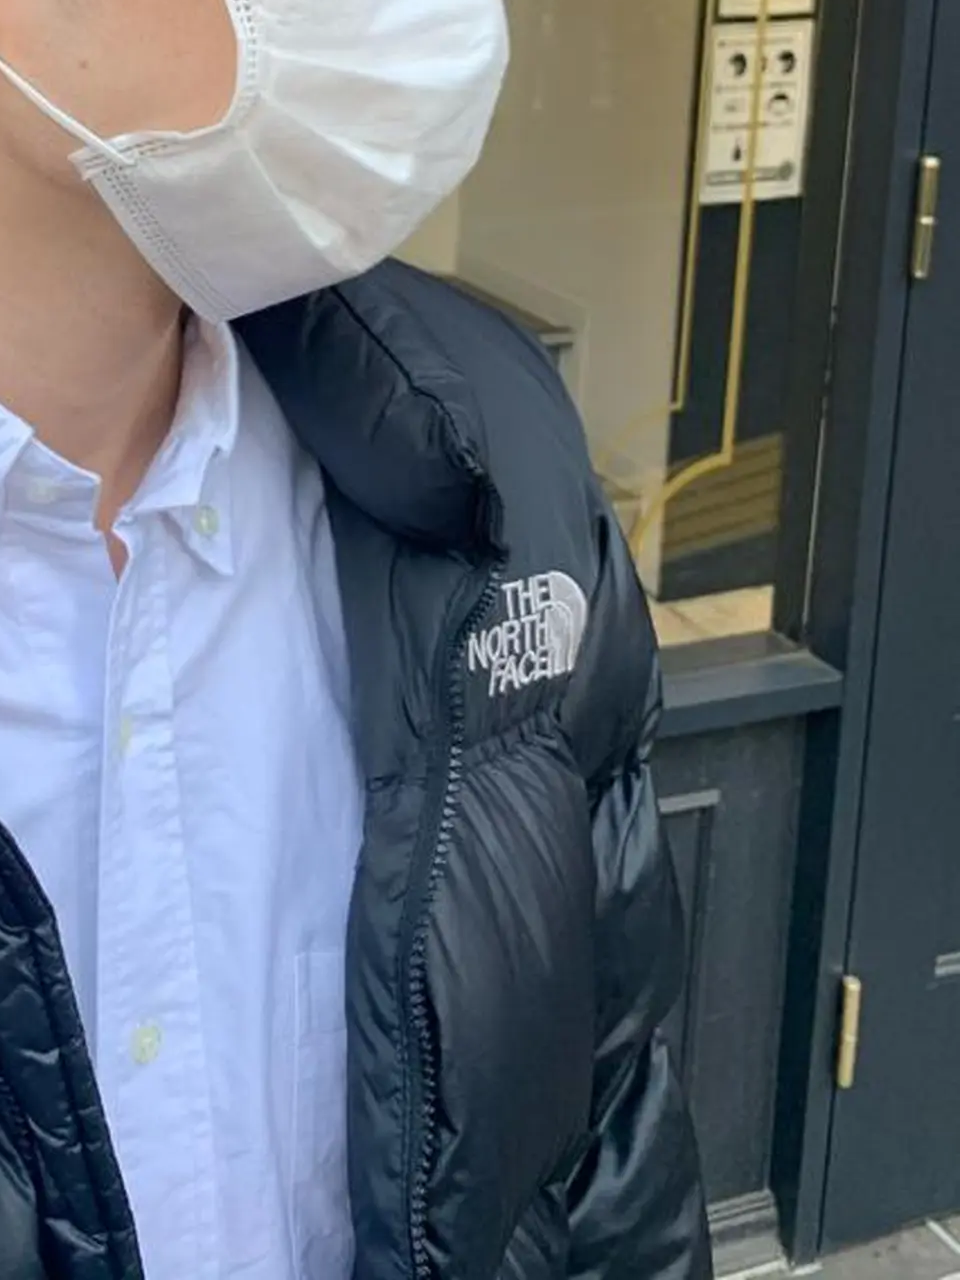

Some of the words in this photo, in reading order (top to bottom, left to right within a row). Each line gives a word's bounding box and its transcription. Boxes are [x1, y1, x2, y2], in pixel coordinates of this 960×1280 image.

[501, 574, 552, 620] THE
[468, 609, 549, 671] NORTH
[489, 648, 553, 697] FACE
